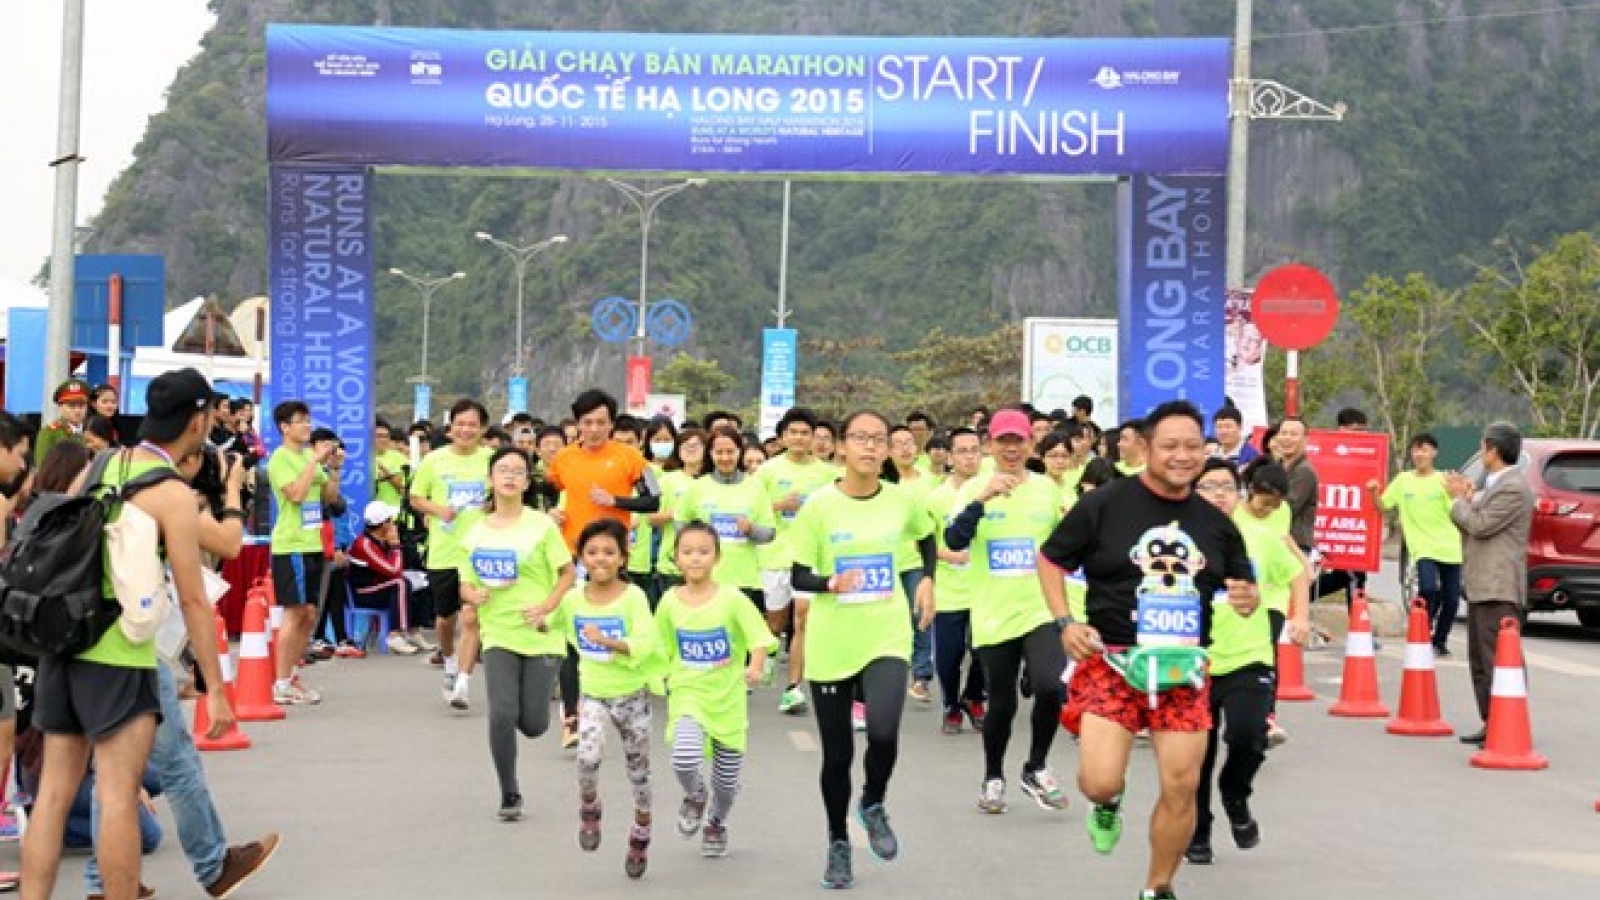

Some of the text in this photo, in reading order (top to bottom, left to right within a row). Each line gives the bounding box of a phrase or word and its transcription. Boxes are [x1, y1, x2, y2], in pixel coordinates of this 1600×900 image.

[485, 43, 865, 79] GIẢI CHẠY BÁN MARATHON
[876, 54, 1046, 106] START/
[485, 73, 864, 119] QUỐC TẾ HẠ LONG 2015
[969, 110, 1126, 156] FINISH
[280, 173, 299, 223] Runs
[336, 174, 364, 257] RUNS
[1146, 175, 1187, 269] BAY
[280, 231, 300, 261] for
[303, 174, 332, 321] NATURAL
[276, 267, 299, 336] strong
[336, 265, 364, 302] AT
[1193, 186, 1212, 378] MARATHON
[336, 311, 364, 336] A
[1066, 335, 1112, 353] OCB
[336, 345, 365, 485] WORLD'S
[1317, 483, 1361, 511] m
[475, 558, 515, 578] 5038
[992, 549, 1035, 568] 5002
[1143, 607, 1199, 633] 5005
[682, 638, 726, 659] 5039
